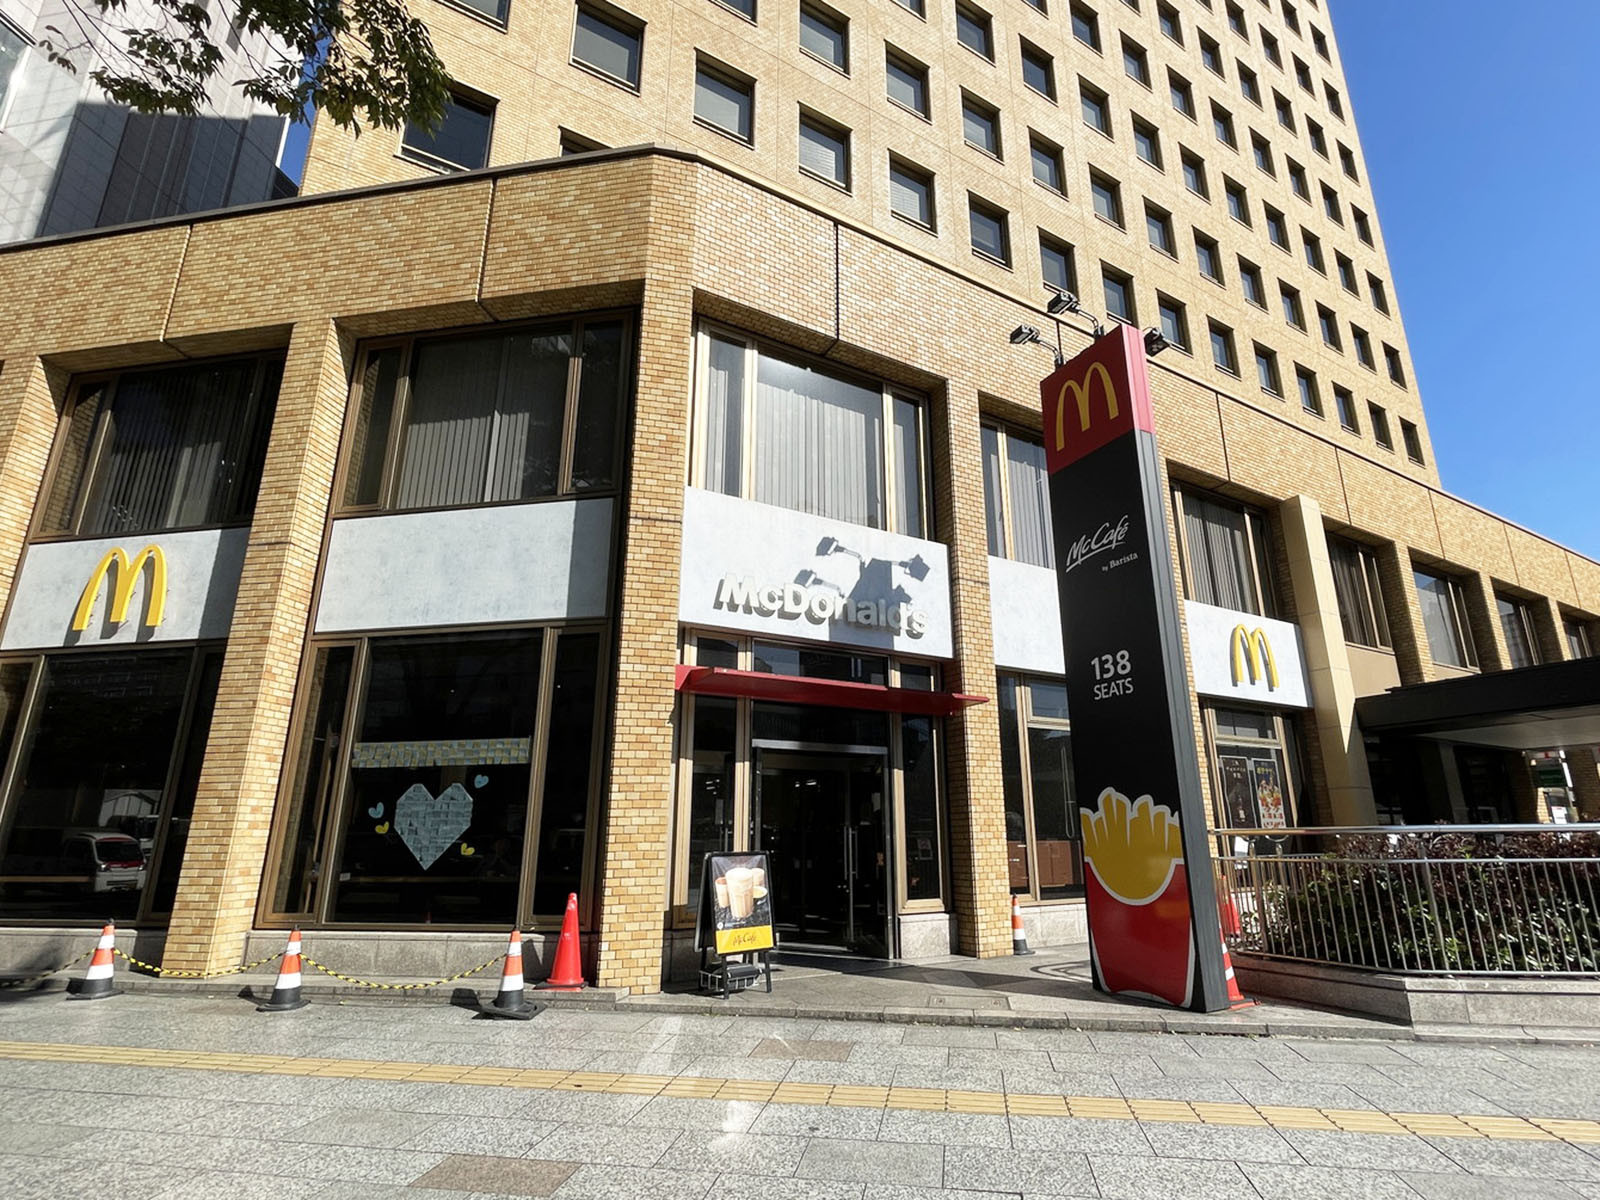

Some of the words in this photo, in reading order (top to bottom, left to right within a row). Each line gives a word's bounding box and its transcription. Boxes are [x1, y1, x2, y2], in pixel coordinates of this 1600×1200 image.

[1066, 514, 1129, 566] McCafé
[1109, 552, 1139, 569] Barista
[718, 572, 929, 635] McDonald's
[1090, 650, 1132, 680] 138
[1093, 677, 1134, 700] SEATS
